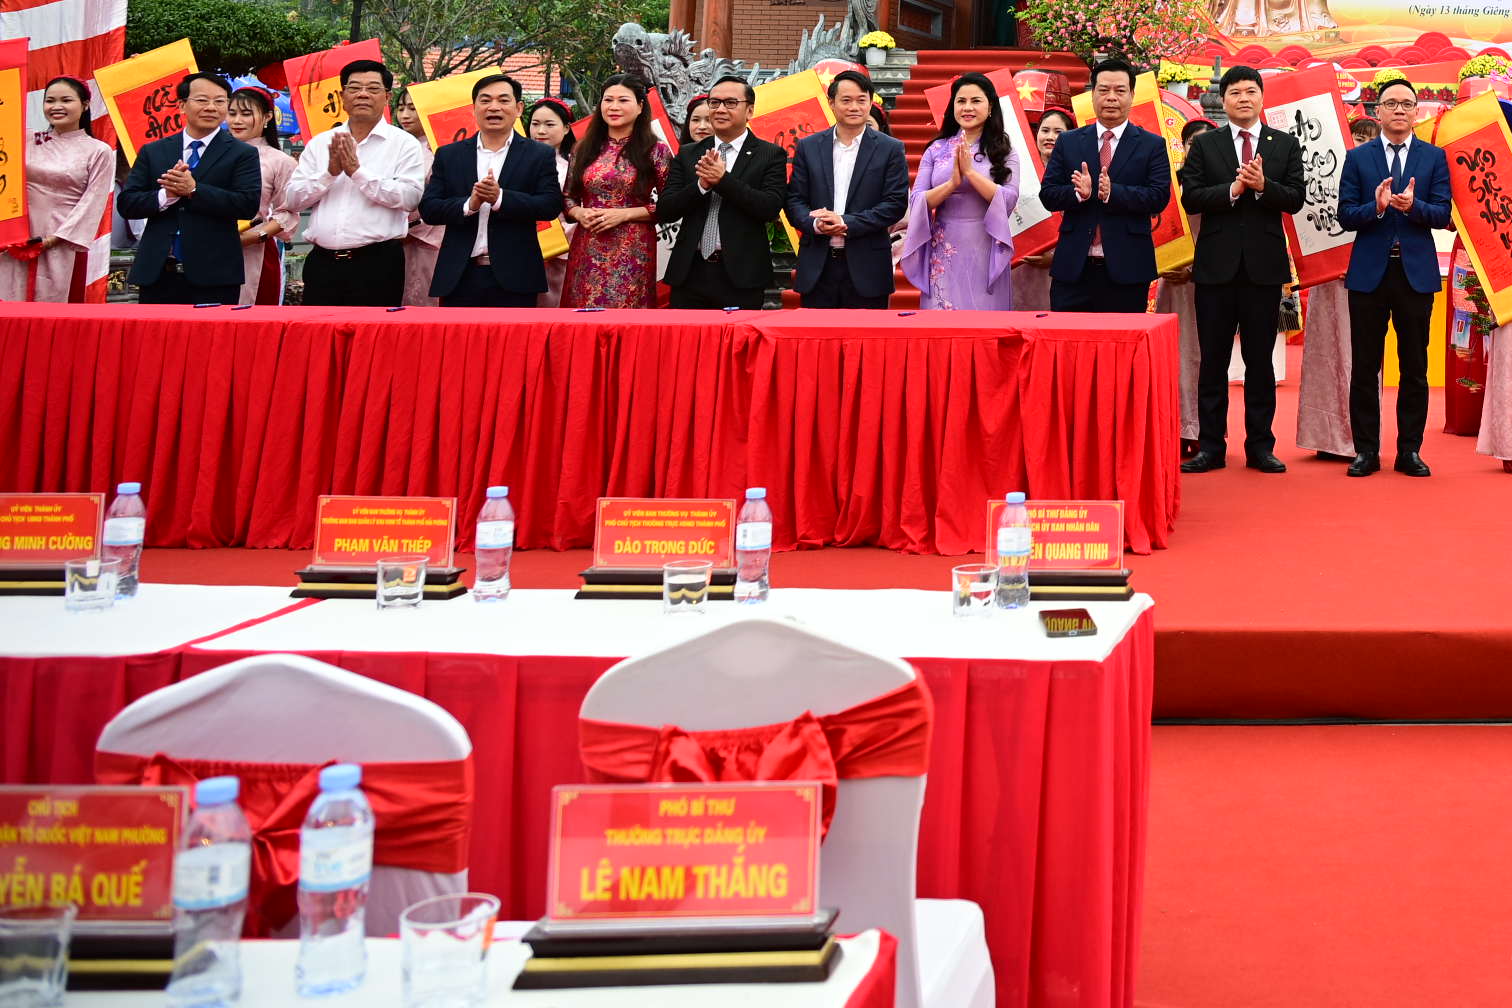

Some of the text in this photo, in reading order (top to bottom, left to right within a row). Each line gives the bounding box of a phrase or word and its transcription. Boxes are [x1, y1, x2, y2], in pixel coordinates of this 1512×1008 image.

[1408, 4, 1437, 16] (Ngày
[1439, 5, 1450, 14] 13
[1453, 5, 1480, 17] tháng
[1482, 5, 1509, 17] Giêng
[14, 535, 46, 550] MINH
[49, 532, 94, 550] CƯỜNG
[334, 535, 432, 557] PHẠM VĂN THÉP
[614, 537, 716, 558] ĐÀO TRỌNG ĐỨC
[1045, 543, 1081, 561] QUANG
[1084, 543, 1108, 560] VINH
[659, 795, 736, 816] PHÓ BÍ THƯ
[604, 820, 767, 848] THƯỜNG TRỰC ĐẢNG ỦY
[51, 864, 85, 906] BÁ
[91, 858, 149, 906] QUẾ
[580, 844, 788, 901] LÊ NAM THẮNG
